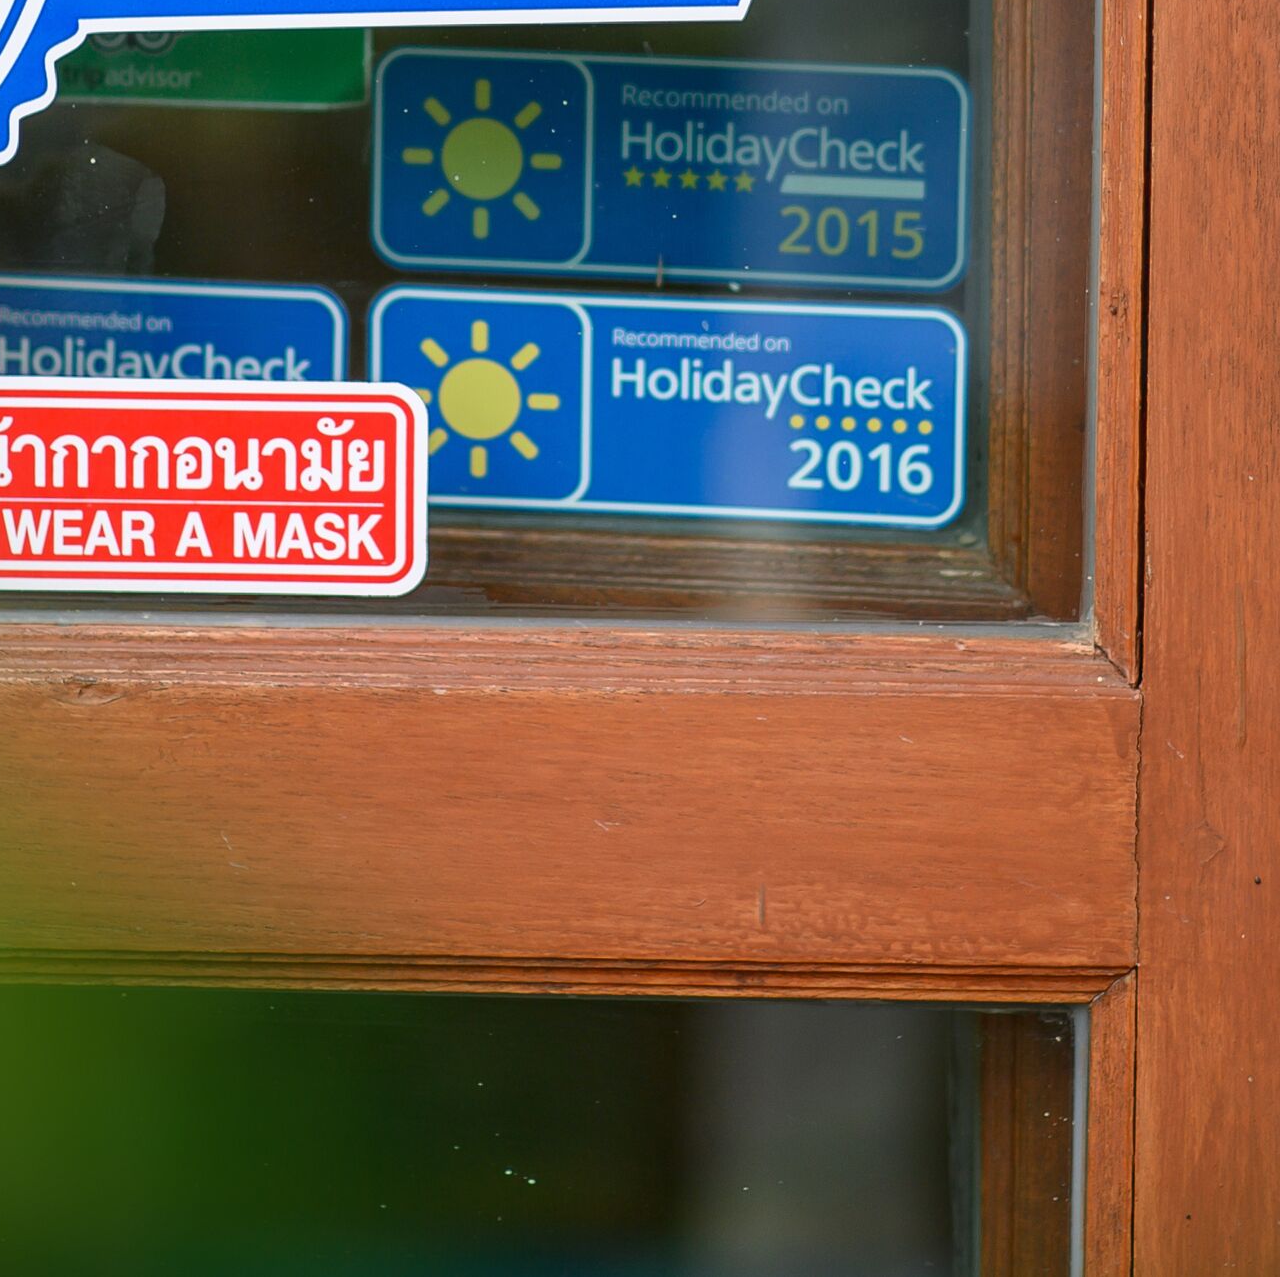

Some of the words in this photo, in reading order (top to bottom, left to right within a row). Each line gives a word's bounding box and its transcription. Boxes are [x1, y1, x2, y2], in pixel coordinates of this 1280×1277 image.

[622, 84, 808, 114] Recommended
[816, 95, 849, 115] on
[622, 120, 924, 182] HolidayCheck
[778, 205, 924, 259] 2015
[146, 315, 173, 332] on
[613, 328, 759, 353] Recommended
[764, 336, 789, 353] on
[612, 357, 933, 419] HolidayCheck
[788, 438, 934, 495] 2016
[2, 509, 156, 558] WEAR
[176, 511, 213, 558] A
[231, 512, 385, 562] MASK
